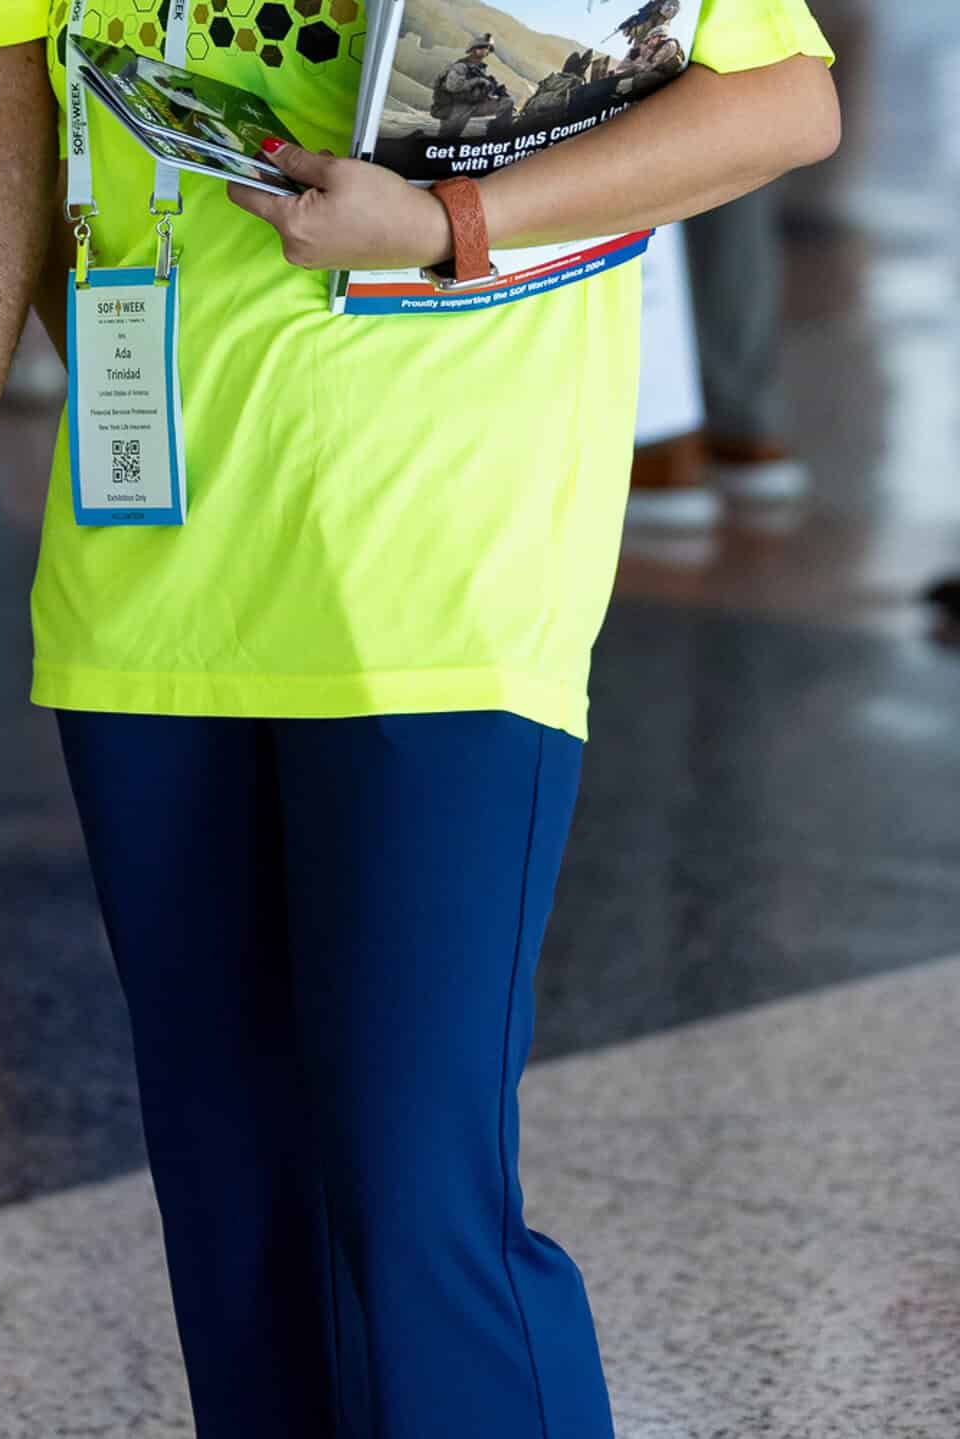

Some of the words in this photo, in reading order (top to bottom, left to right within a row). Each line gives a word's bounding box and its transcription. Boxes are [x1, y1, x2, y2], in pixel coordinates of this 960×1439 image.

[71, 82, 81, 119] WEEK
[73, 130, 84, 156] SOF
[425, 146, 455, 160] Get
[459, 142, 511, 159] Better
[514, 131, 547, 151] UAS
[550, 117, 596, 141] Comm
[451, 158, 488, 172] with
[493, 149, 539, 168] Bett
[401, 298, 439, 309] Proudly
[440, 295, 491, 308] supporting
[493, 287, 508, 299] the
[509, 285, 528, 297] SOF
[527, 276, 560, 292] Warrior
[560, 267, 583, 281] since
[585, 258, 606, 273] 2004
[97, 303, 114, 314] SOF
[123, 302, 146, 312] WEEK
[114, 346, 132, 359] Ada
[106, 368, 141, 380] Trinidad
